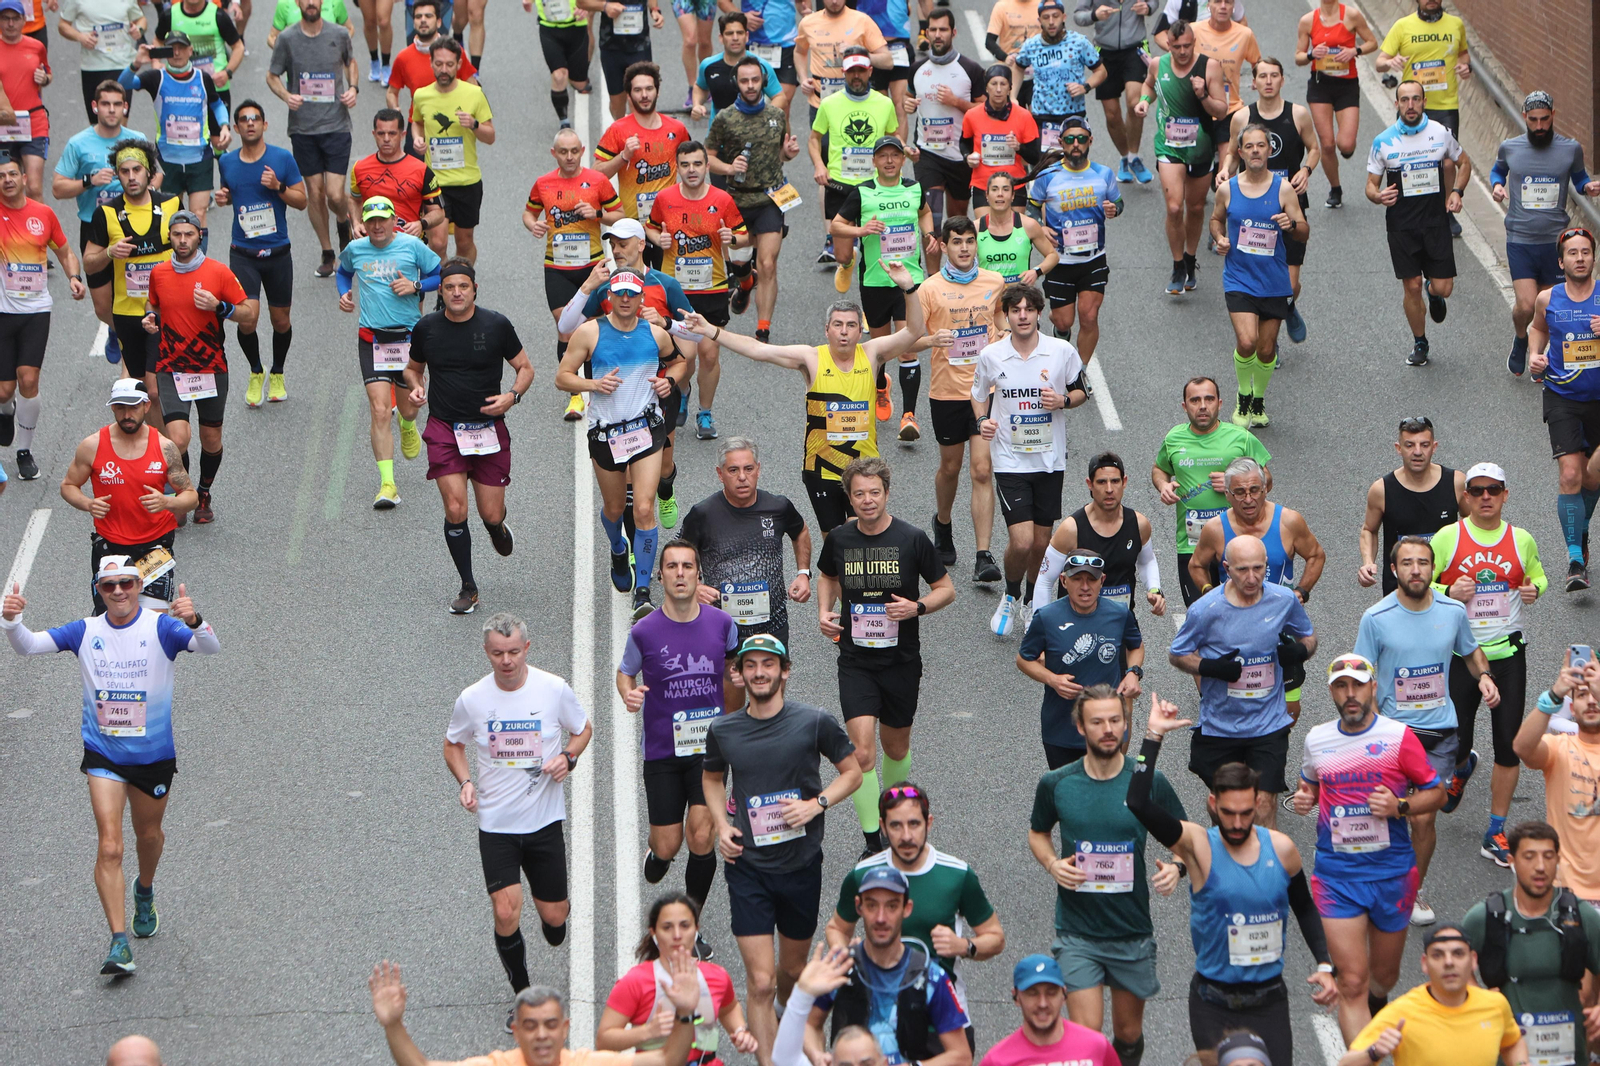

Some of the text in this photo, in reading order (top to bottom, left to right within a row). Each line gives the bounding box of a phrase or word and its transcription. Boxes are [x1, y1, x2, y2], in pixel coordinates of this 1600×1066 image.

[1036, 48, 1063, 68] COMO
[1422, 61, 1442, 69] ZURICH
[311, 72, 331, 80] ZURICH
[1057, 185, 1095, 201] TEAM
[248, 203, 269, 211] ZURICH
[878, 200, 911, 211] sano
[892, 225, 912, 233] ZURICH
[1254, 221, 1275, 229] ZURICH
[985, 252, 1017, 263] sano
[20, 264, 40, 272] ZURICH
[138, 263, 158, 271] ZURIC
[949, 305, 970, 314] Maratón
[961, 327, 984, 336] ZURICH
[1577, 332, 1599, 341] ZURIC
[961, 340, 976, 348] 7519
[1577, 344, 1593, 352] 4331
[187, 375, 202, 384] 7223
[1001, 388, 1042, 399] SIEME
[841, 402, 865, 410] ZURICH
[1018, 400, 1044, 411] mob
[841, 416, 857, 424] 5369
[1024, 415, 1048, 424] ZURICH
[1024, 428, 1040, 436] 9033
[622, 435, 639, 446] 7395
[1178, 456, 1224, 468] edp MARATONA
[1200, 509, 1225, 519] ZURICH
[1563, 502, 1578, 543] Kalenji
[762, 529, 775, 539] OTSO
[843, 546, 900, 562] RUN UTREG
[844, 560, 900, 575] RUN UTREG
[1458, 551, 1513, 575] ITALIA
[844, 574, 902, 589] RUN UTREG
[737, 583, 765, 592] ZURICH
[1102, 586, 1128, 596] ZURICH
[1476, 583, 1505, 594] ZURICH
[737, 597, 754, 606] 8594
[1477, 598, 1495, 608] 6757
[866, 605, 888, 613] ZURIC
[1474, 610, 1500, 618] ANTONIO
[866, 619, 884, 628] 7435
[108, 658, 148, 670] CALIFATO
[1247, 655, 1272, 666] ZURICH
[1246, 670, 1263, 679] 7494
[1412, 665, 1440, 677] ZURICH
[106, 681, 136, 691] SEVILLA
[668, 676, 713, 690] MURCIA
[1246, 682, 1262, 690] NONO
[1412, 681, 1431, 690] 7495
[664, 682, 718, 700] MARATÓN
[111, 693, 140, 701] ZURICH
[110, 706, 129, 717] 7415
[689, 708, 717, 720] ZURICH
[505, 722, 536, 731] ZURICH
[690, 724, 709, 735] 9106
[505, 738, 524, 747] 8080
[677, 739, 698, 747] ALVARO
[496, 750, 535, 759] PETER RYDZI
[1348, 806, 1371, 816] ZURIC
[1349, 822, 1369, 832] 7220
[1095, 844, 1128, 854] ZURICH
[1095, 860, 1115, 870] 7662
[1094, 873, 1116, 882] ZIMON
[1249, 912, 1279, 924] ZURICH
[1249, 932, 1269, 941] 8230
[1537, 1012, 1570, 1025] ZURICH
